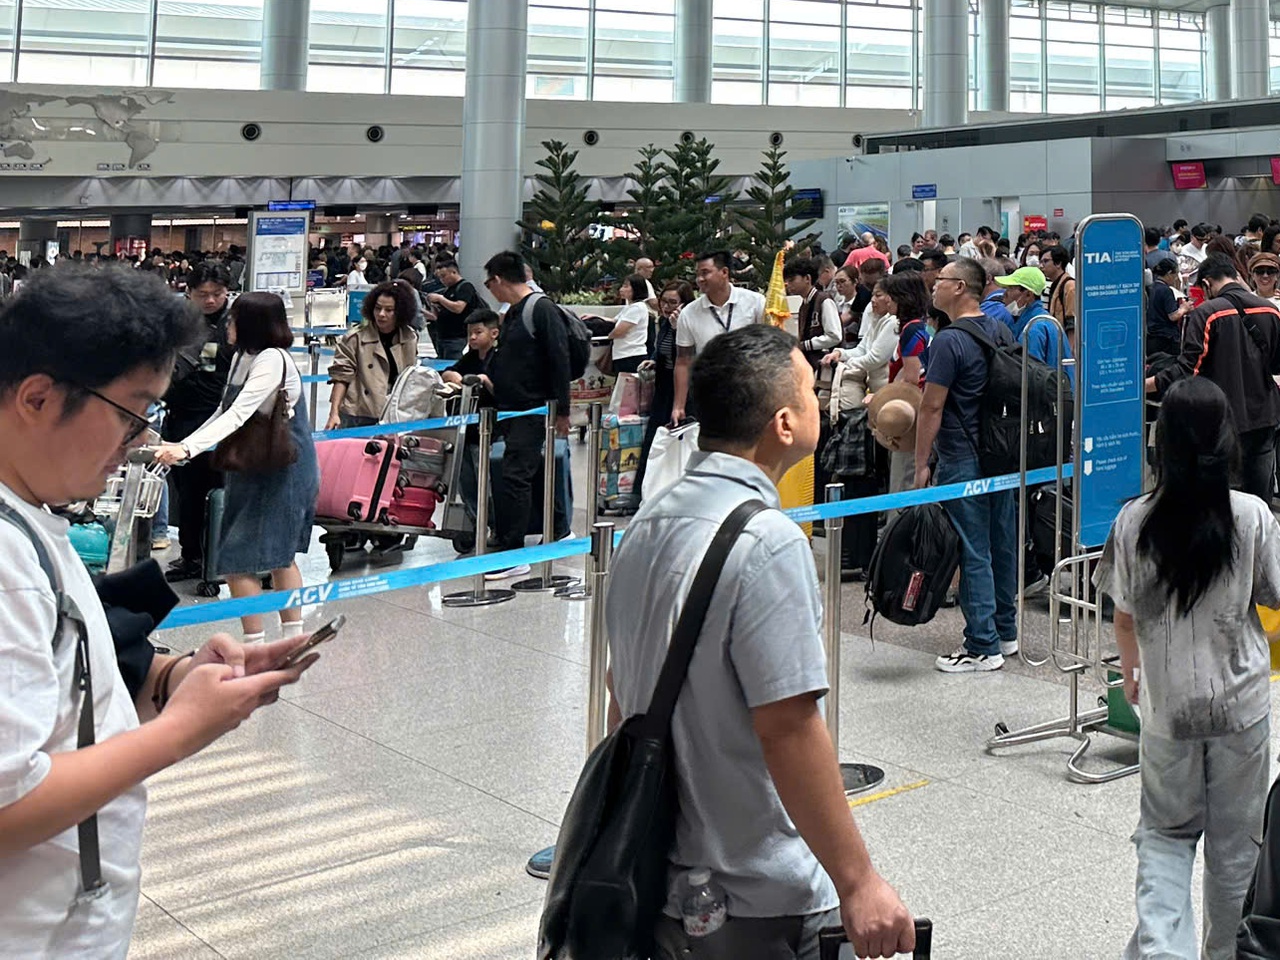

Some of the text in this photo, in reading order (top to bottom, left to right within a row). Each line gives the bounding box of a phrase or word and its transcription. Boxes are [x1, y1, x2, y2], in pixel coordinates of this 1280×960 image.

[1084, 252, 1112, 264] TIA
[444, 414, 469, 427] ACV
[962, 478, 992, 497] ACV
[285, 583, 334, 609] ACV
